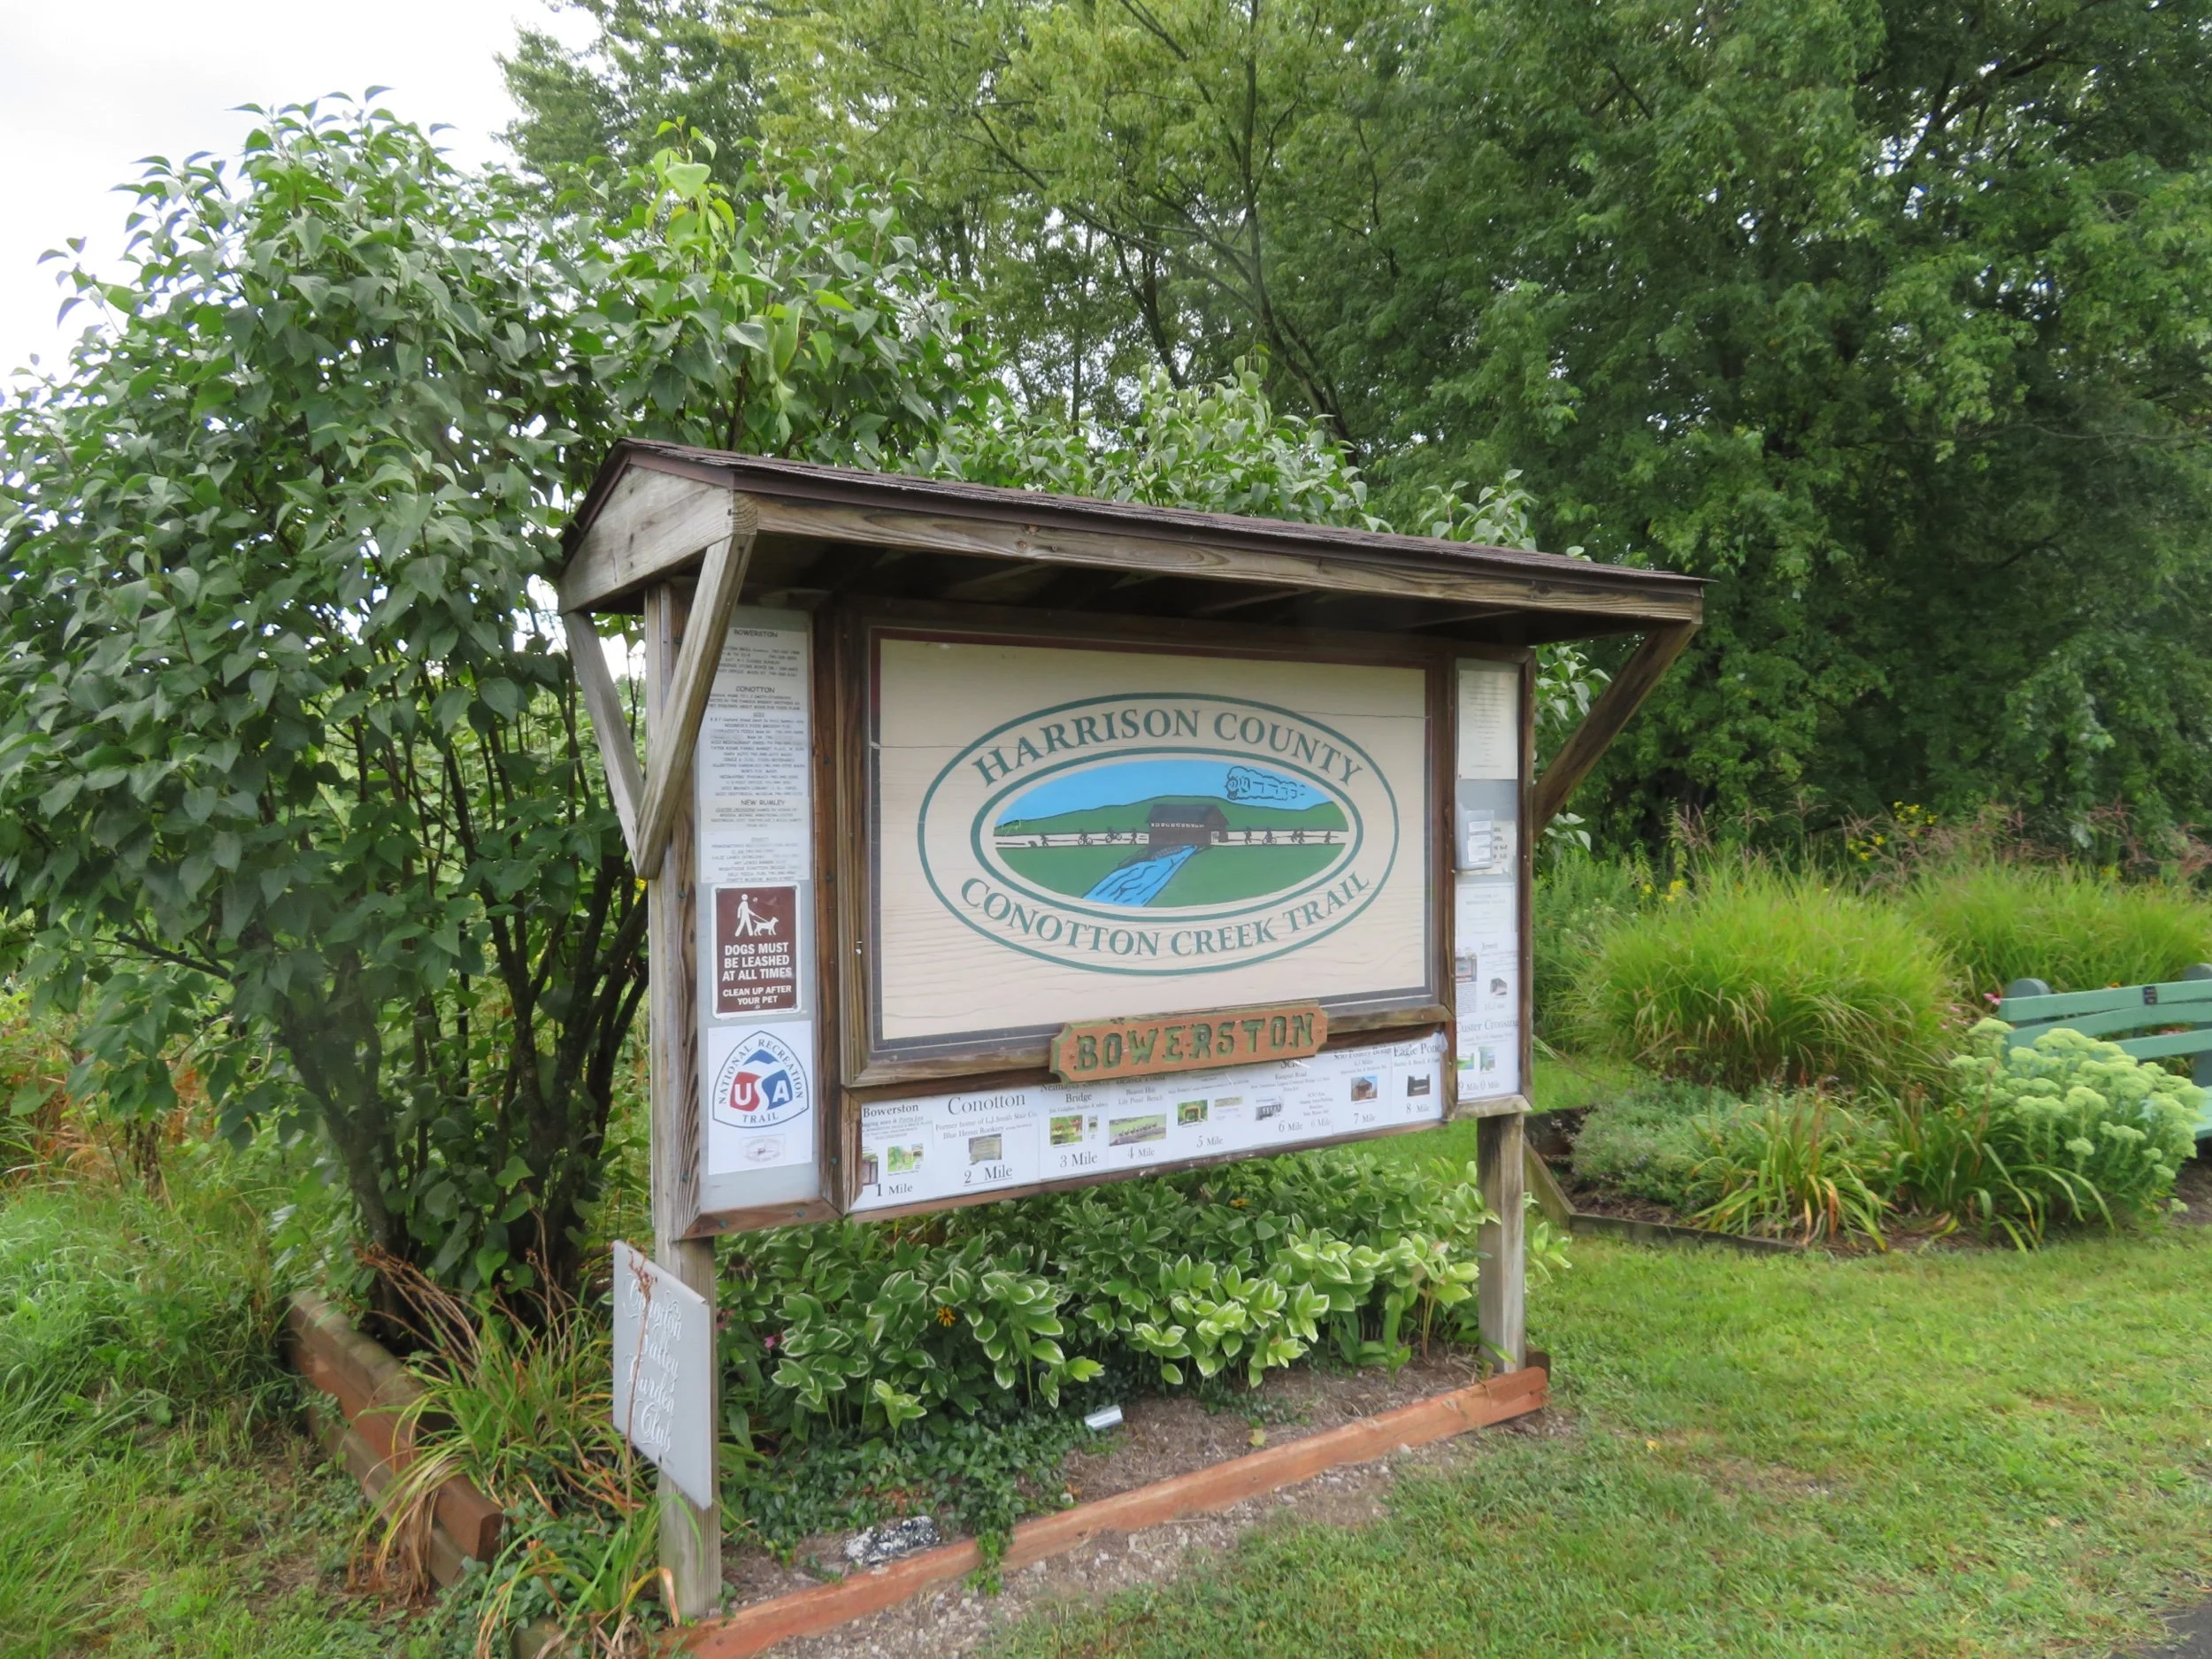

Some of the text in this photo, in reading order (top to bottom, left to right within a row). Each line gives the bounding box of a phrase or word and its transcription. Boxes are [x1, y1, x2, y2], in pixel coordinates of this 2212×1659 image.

[733, 628, 778, 637] BOWERSTON
[972, 709, 1363, 787] HARRISON COUNTY
[961, 871, 1369, 956] CONOTTON CREEK TRAIL
[725, 942, 788, 956] DOGS MUST
[724, 955, 790, 968] BE LEASHED
[722, 967, 793, 981] AT ALL TIMES
[722, 987, 750, 997] CLEAN
[765, 985, 792, 995] AFTER
[1073, 1013, 1315, 1071] BOWERSTON
[718, 1039, 803, 1104] NATIONAL RECREATION
[733, 1078, 791, 1109] USA
[1066, 1093, 1092, 1103] Bridge
[864, 1104, 918, 1118] Bowerston
[948, 1094, 1025, 1115] Conotton
[1406, 1103, 1411, 1113] 8
[742, 1112, 779, 1124] TRAIL
[1354, 1113, 1376, 1125] 7 Mile
[936, 1122, 956, 1131] Former
[1279, 1119, 1303, 1133] 6 Mile
[1196, 1135, 1223, 1148] 5 Mile
[1060, 1151, 1097, 1168] 3 Mile
[1127, 1147, 1155, 1158] 4 Mile
[964, 1164, 1012, 1184] 2 Mile
[877, 1183, 913, 1196] 1 Mile
[633, 1399, 671, 1452] Club
